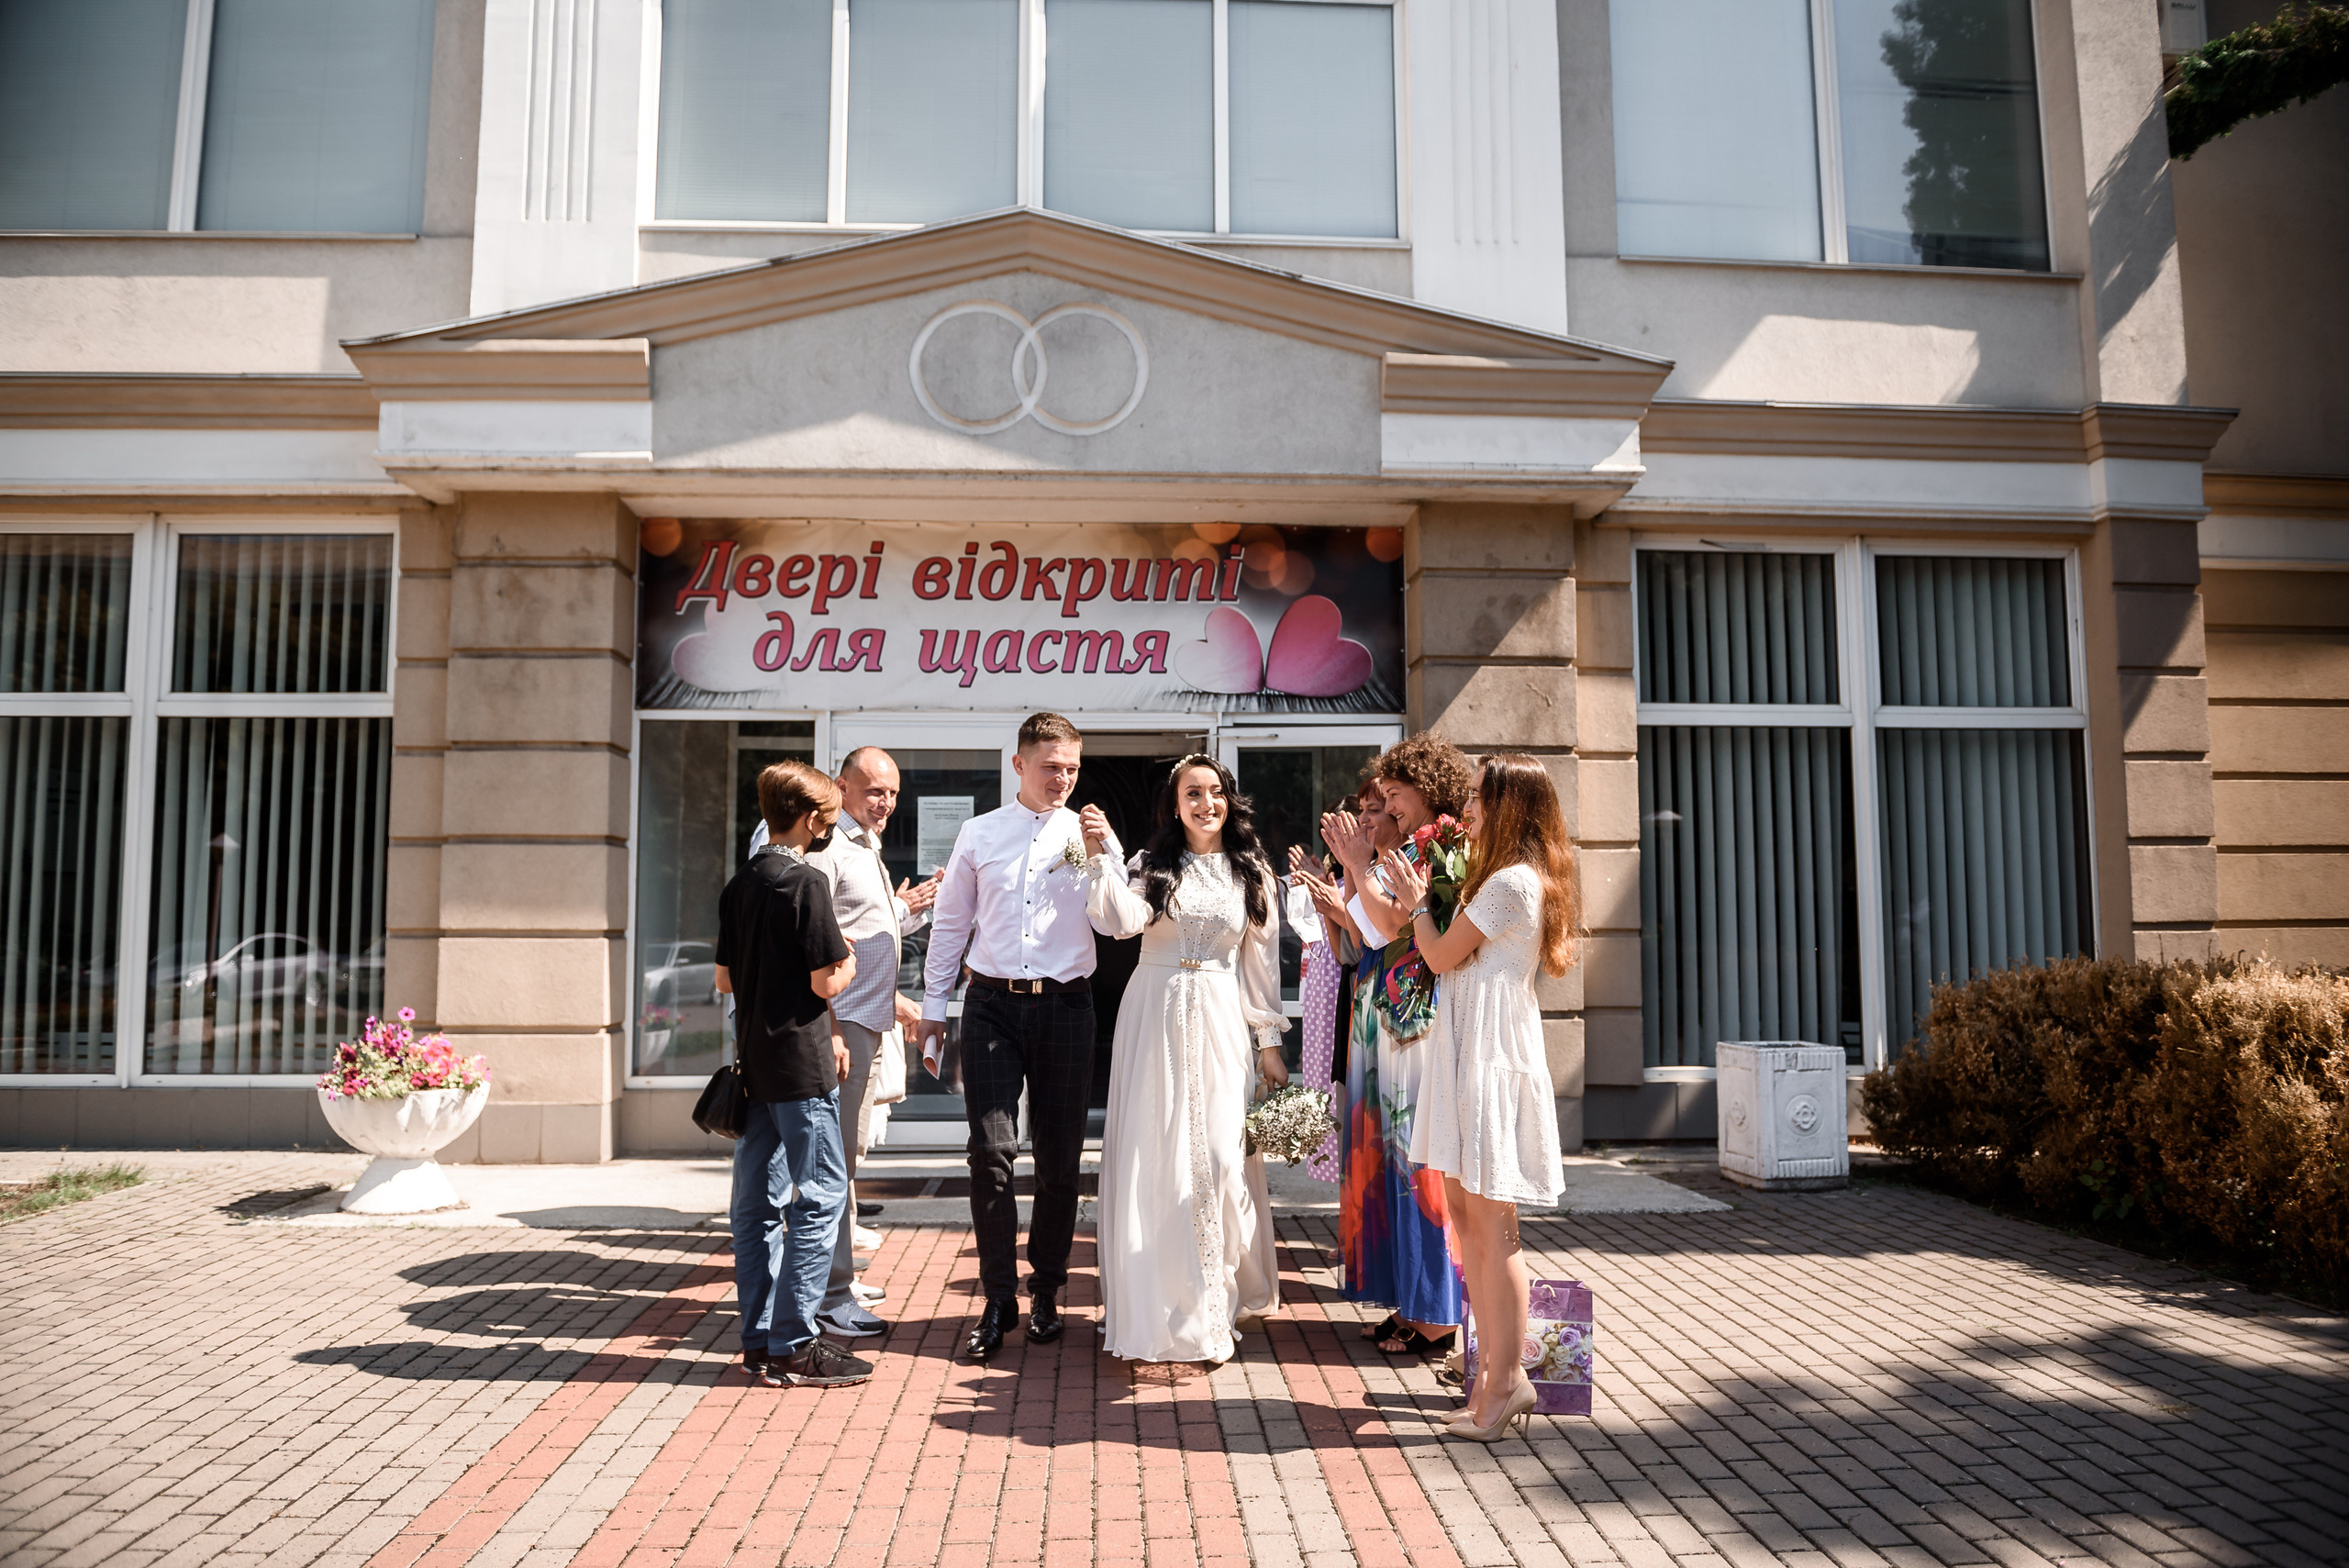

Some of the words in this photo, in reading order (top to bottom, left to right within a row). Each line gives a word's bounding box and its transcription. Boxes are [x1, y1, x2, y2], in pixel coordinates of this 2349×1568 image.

[674, 539, 885, 616] Двері
[911, 539, 1244, 617] відкриті
[752, 610, 886, 673] для
[918, 628, 1171, 688] щастя
